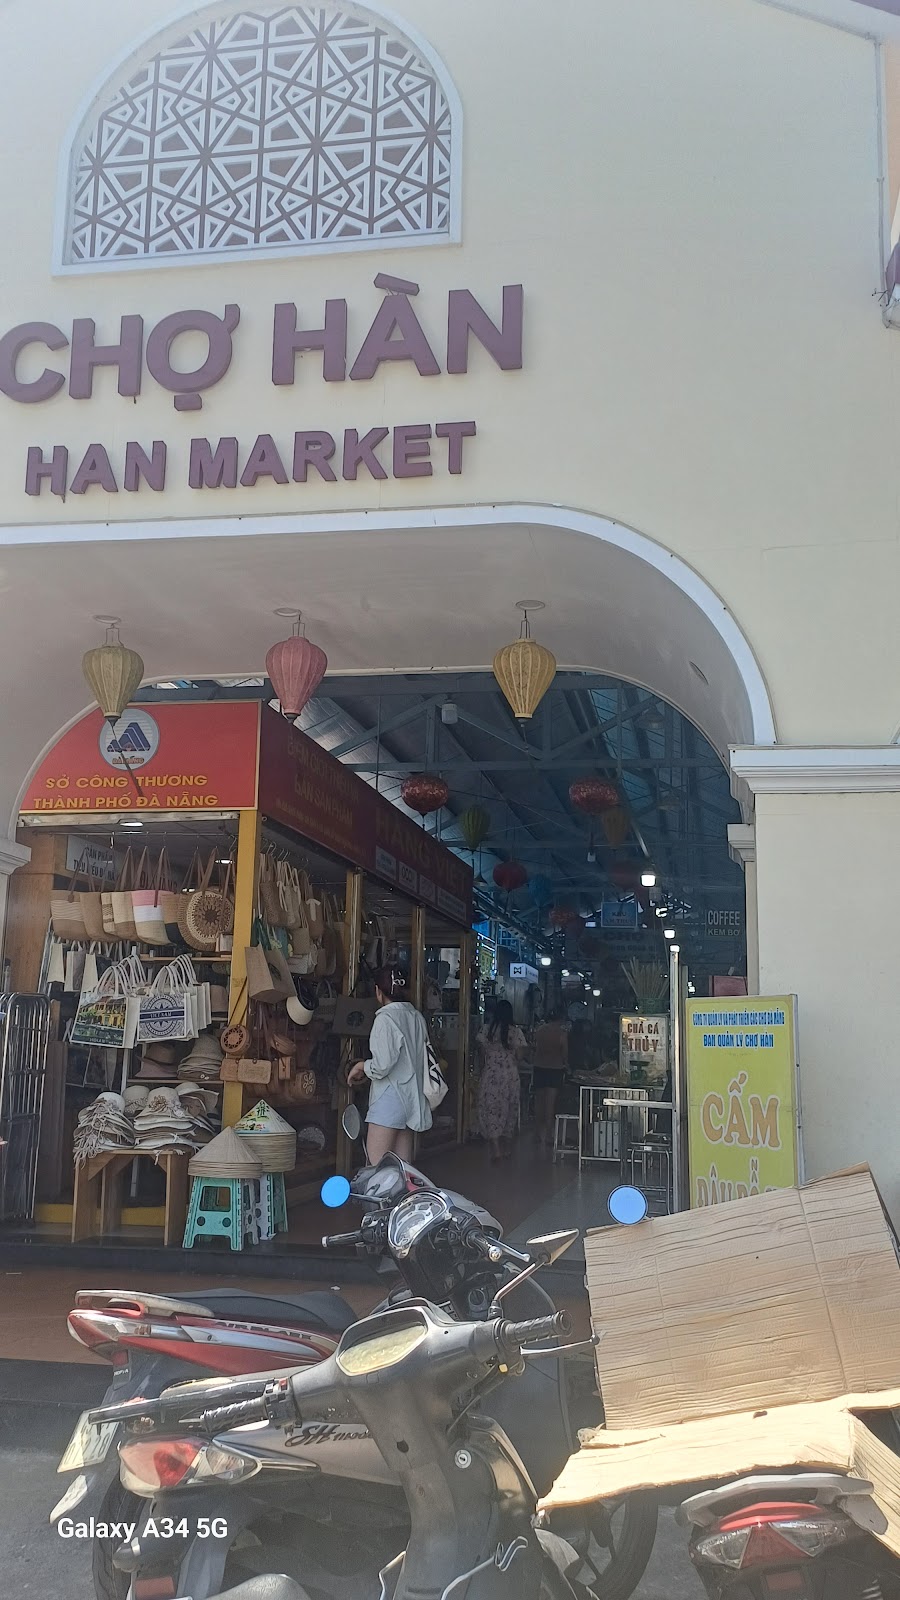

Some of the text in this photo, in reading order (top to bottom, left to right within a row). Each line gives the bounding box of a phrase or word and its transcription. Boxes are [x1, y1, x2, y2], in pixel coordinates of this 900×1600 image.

[0, 273, 523, 411] CHỢ HÀN
[25, 421, 477, 496] HAN MARKET
[46, 774, 208, 788] SỞ CÔNG THƯƠNG
[33, 791, 219, 809] THÀNH PHỐ ĐÀ NẴNG
[708, 910, 741, 926] COFFEE
[703, 1031, 774, 1050] BAN QUẢN LÝ CHỢ HÀN
[702, 1072, 780, 1148] CẤM
